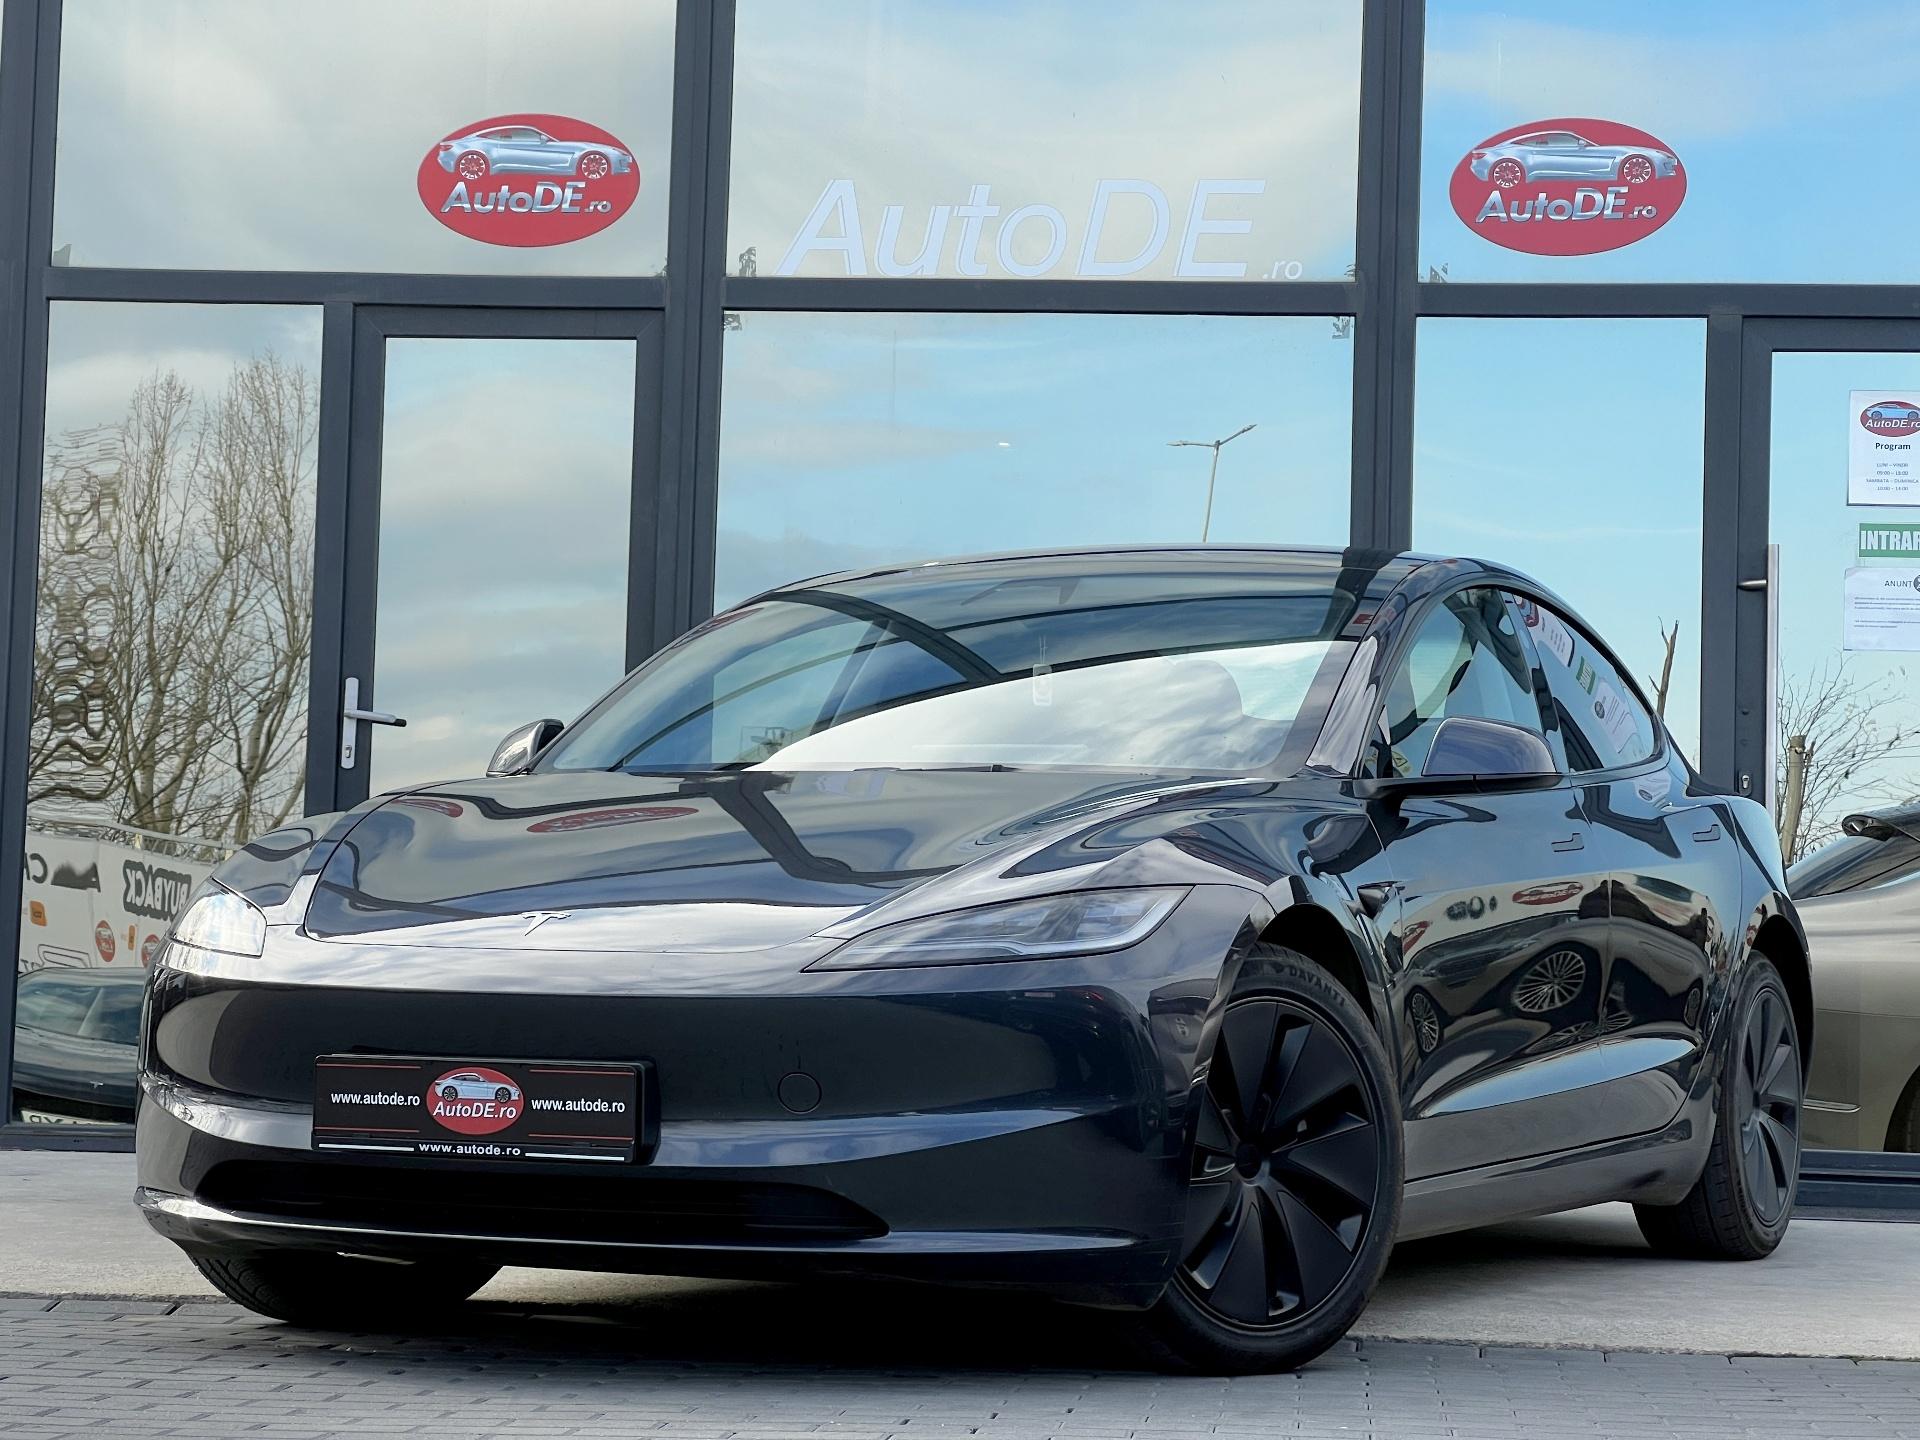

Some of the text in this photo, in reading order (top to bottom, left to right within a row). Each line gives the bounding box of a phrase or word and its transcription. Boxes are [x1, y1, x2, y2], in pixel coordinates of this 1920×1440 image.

[1875, 442, 1911, 451] Program
[1289, 964, 1346, 1007] DAVANTI
[331, 1091, 420, 1107] www.autode.ro
[531, 1098, 625, 1113] www.autode.ro
[432, 1102, 517, 1119] AutoDE.ro
[418, 1142, 521, 1156] www.autode.ro
